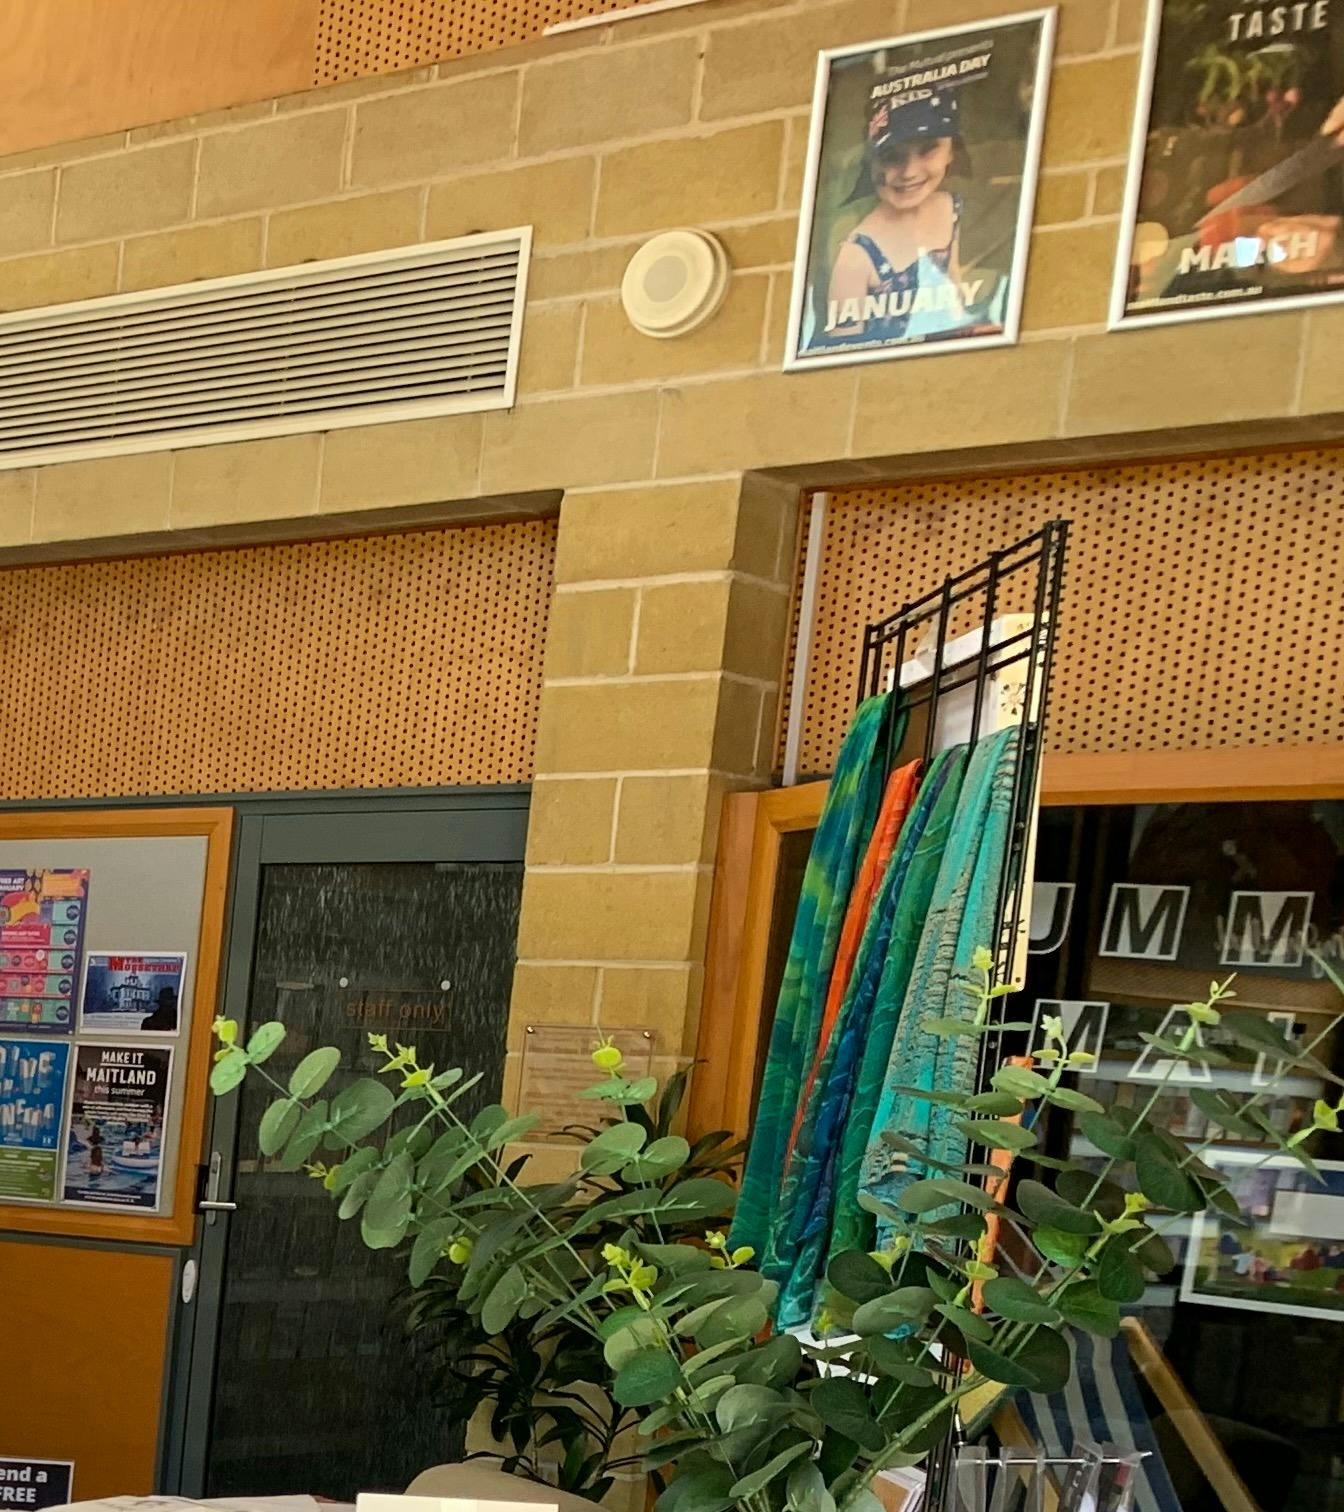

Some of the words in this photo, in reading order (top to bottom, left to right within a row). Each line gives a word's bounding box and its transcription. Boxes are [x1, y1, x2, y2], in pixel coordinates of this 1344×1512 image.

[1228, 1, 1329, 41] TASTE
[871, 63, 958, 100] AUSTRALIA
[959, 53, 992, 75] DAY
[824, 279, 984, 332] JANUARY
[101, 1051, 130, 1064] MAKE
[132, 1053, 144, 1064] IT
[86, 1068, 156, 1085] MAITLAND
[94, 1085, 109, 1095] this
[111, 1087, 146, 1096] summer
[36, 1470, 48, 1483] a
